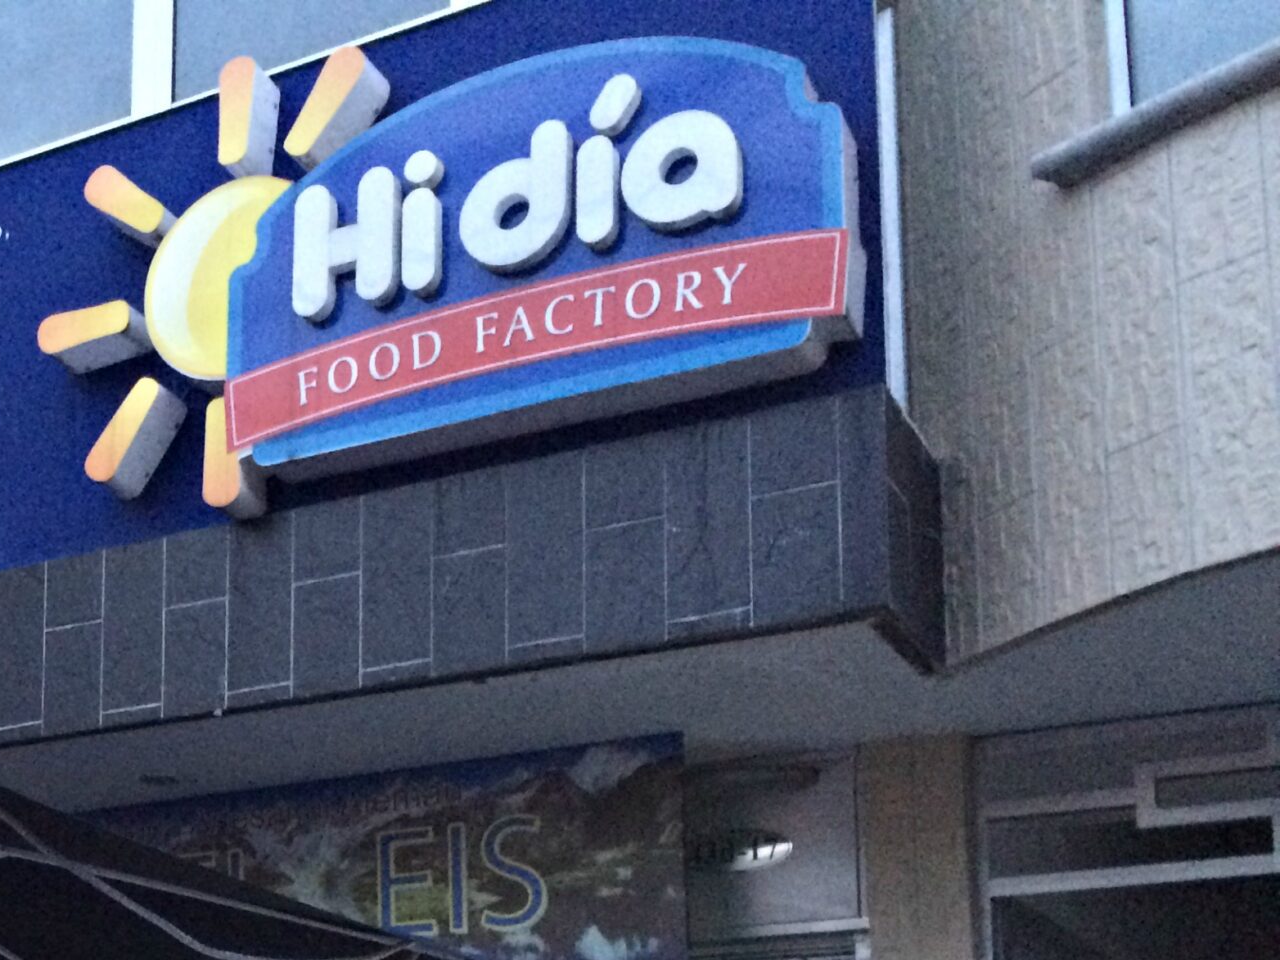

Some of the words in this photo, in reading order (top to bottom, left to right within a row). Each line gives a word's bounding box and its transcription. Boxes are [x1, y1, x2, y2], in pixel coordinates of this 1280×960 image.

[297, 330, 442, 406] FOOD
[474, 262, 748, 354] FACTORY
[376, 813, 549, 936] EIS
